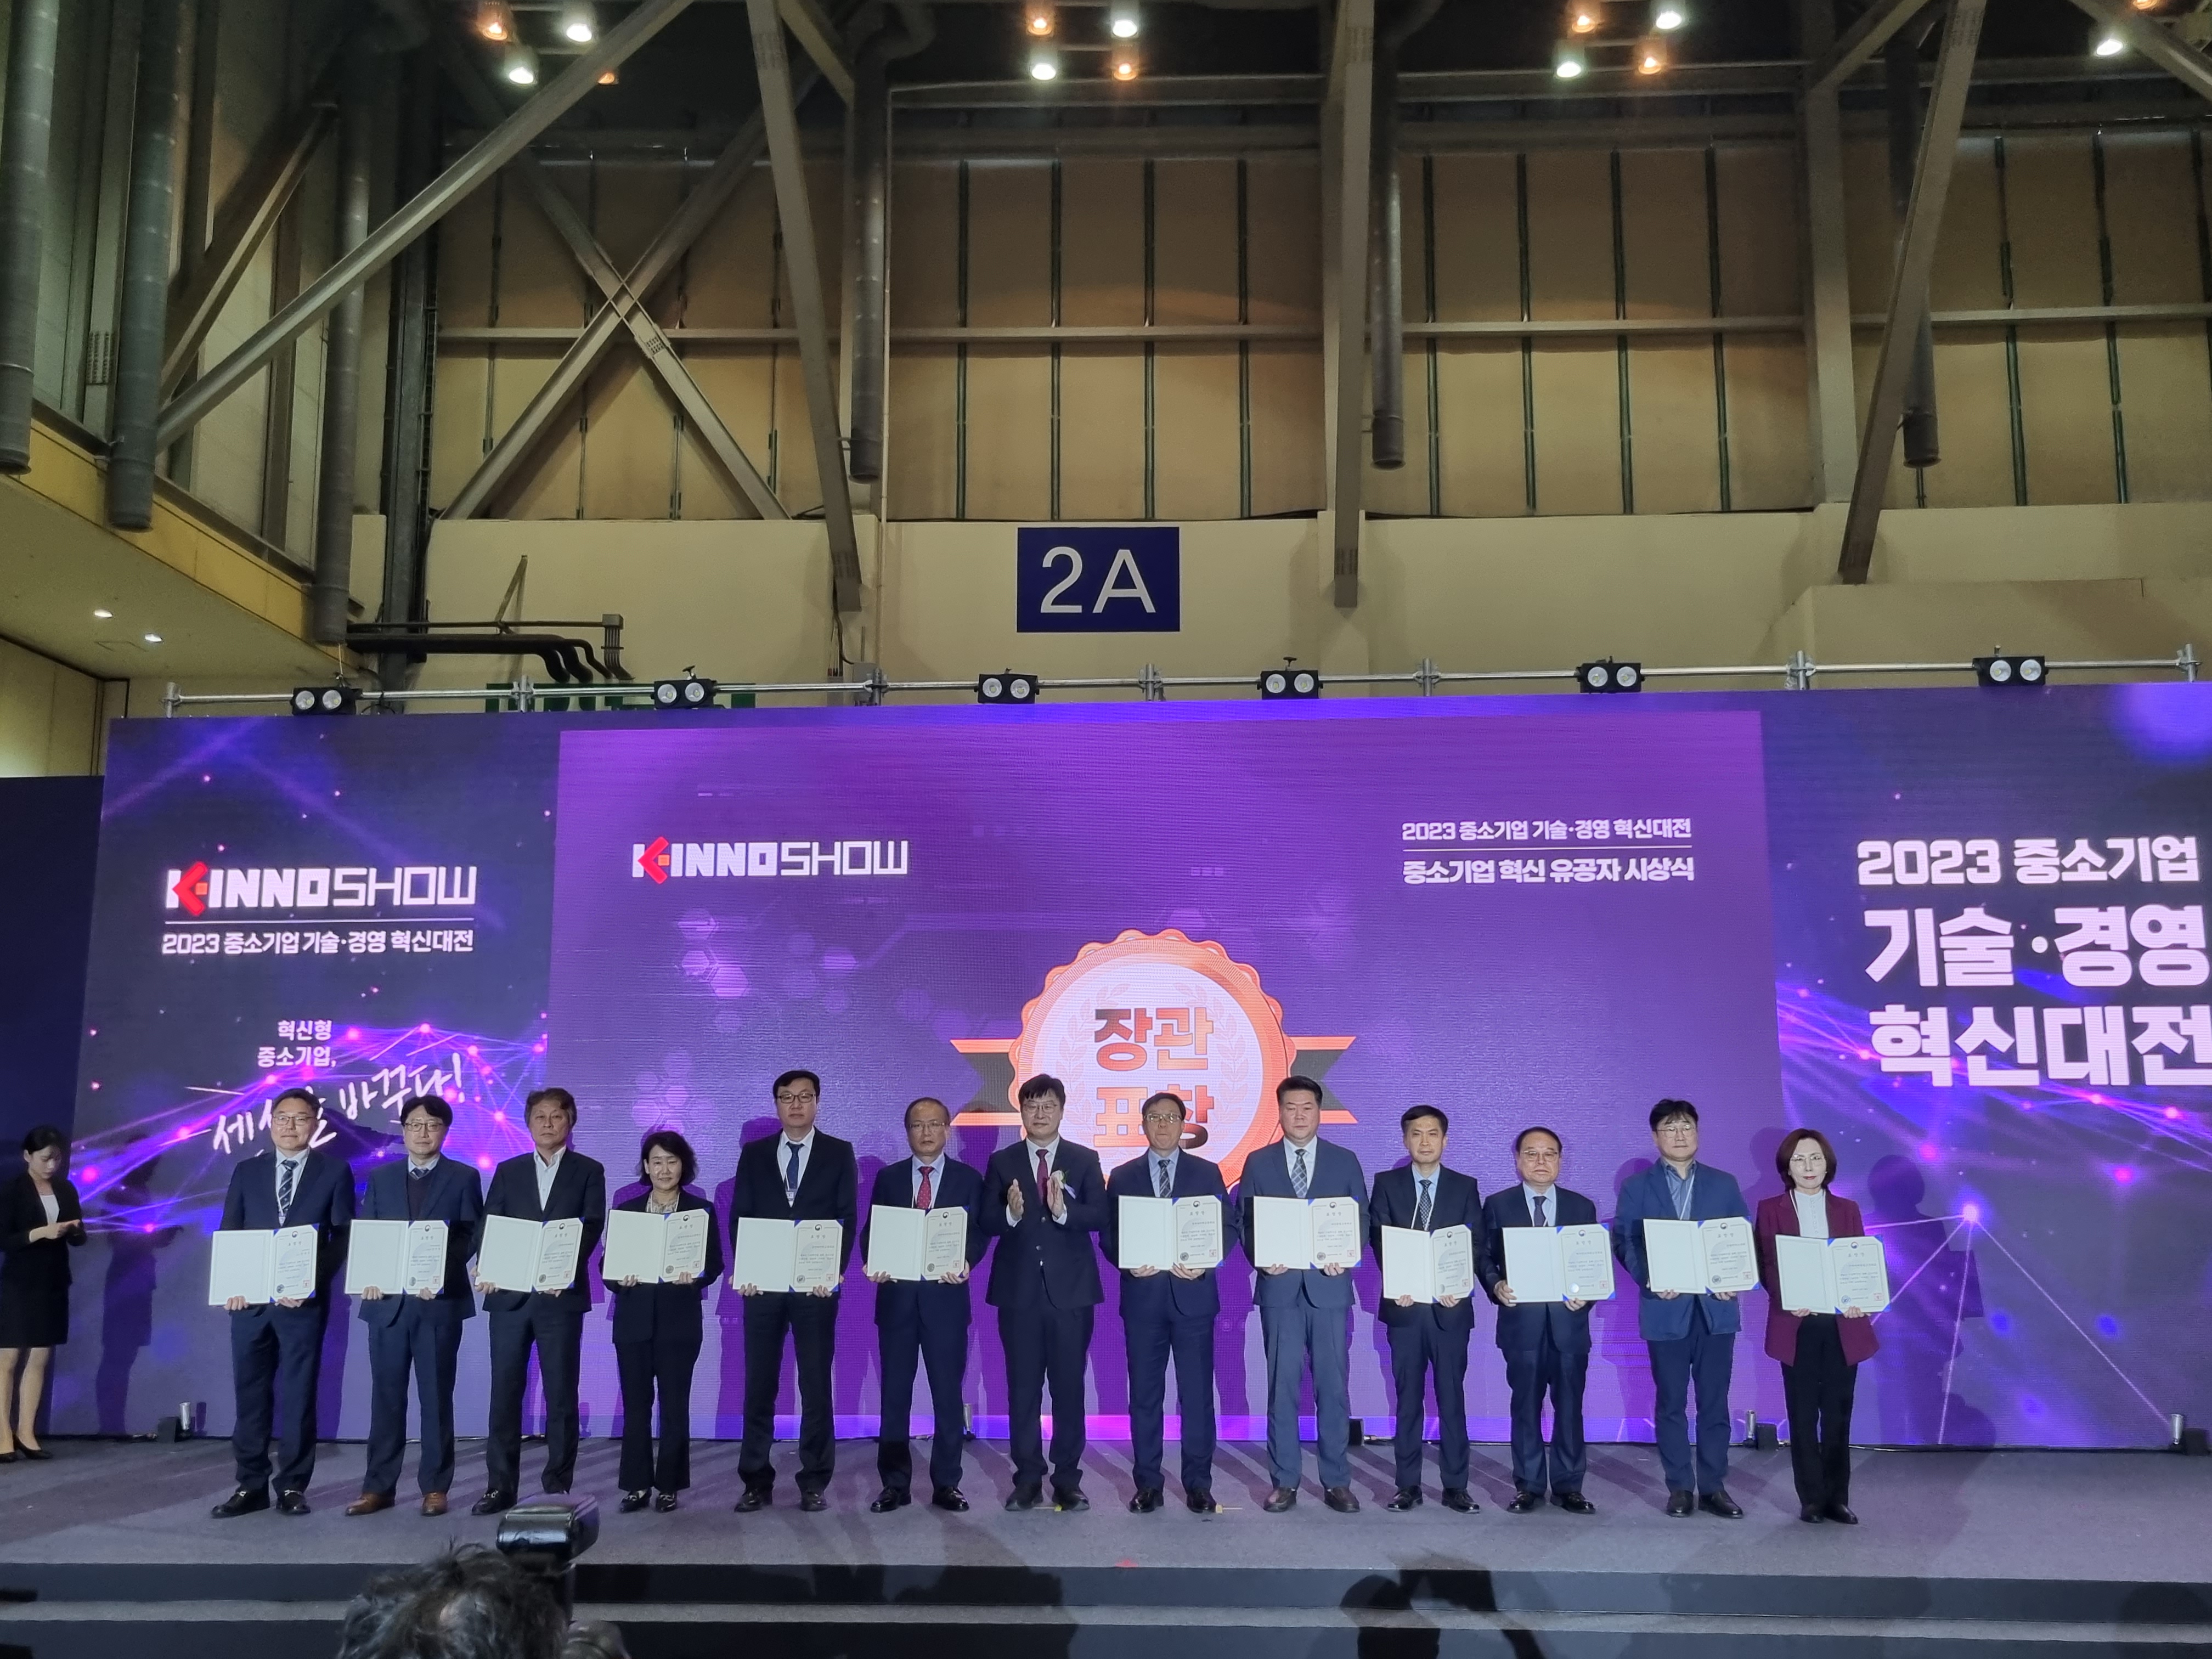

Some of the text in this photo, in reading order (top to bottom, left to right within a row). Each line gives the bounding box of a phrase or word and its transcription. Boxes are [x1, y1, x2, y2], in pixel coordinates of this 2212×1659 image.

[1040, 546, 1156, 613] 2A
[1402, 822, 1455, 840] 2023
[1459, 821, 1528, 840] 중소기업
[1613, 819, 1691, 839] 혁신대전
[1403, 857, 1694, 884] 중소기업 혁신 유공자 시상식
[1858, 837, 2199, 885] 2023 중소기업
[162, 934, 220, 954] 2023
[223, 932, 300, 954] 중소기업
[391, 930, 473, 952] 혁신대전
[278, 1020, 332, 1041] 혁신형
[1094, 1008, 1214, 1071] 장관
[257, 1046, 336, 1067] 중소기업,
[1869, 1005, 2212, 1086] 혁신대전
